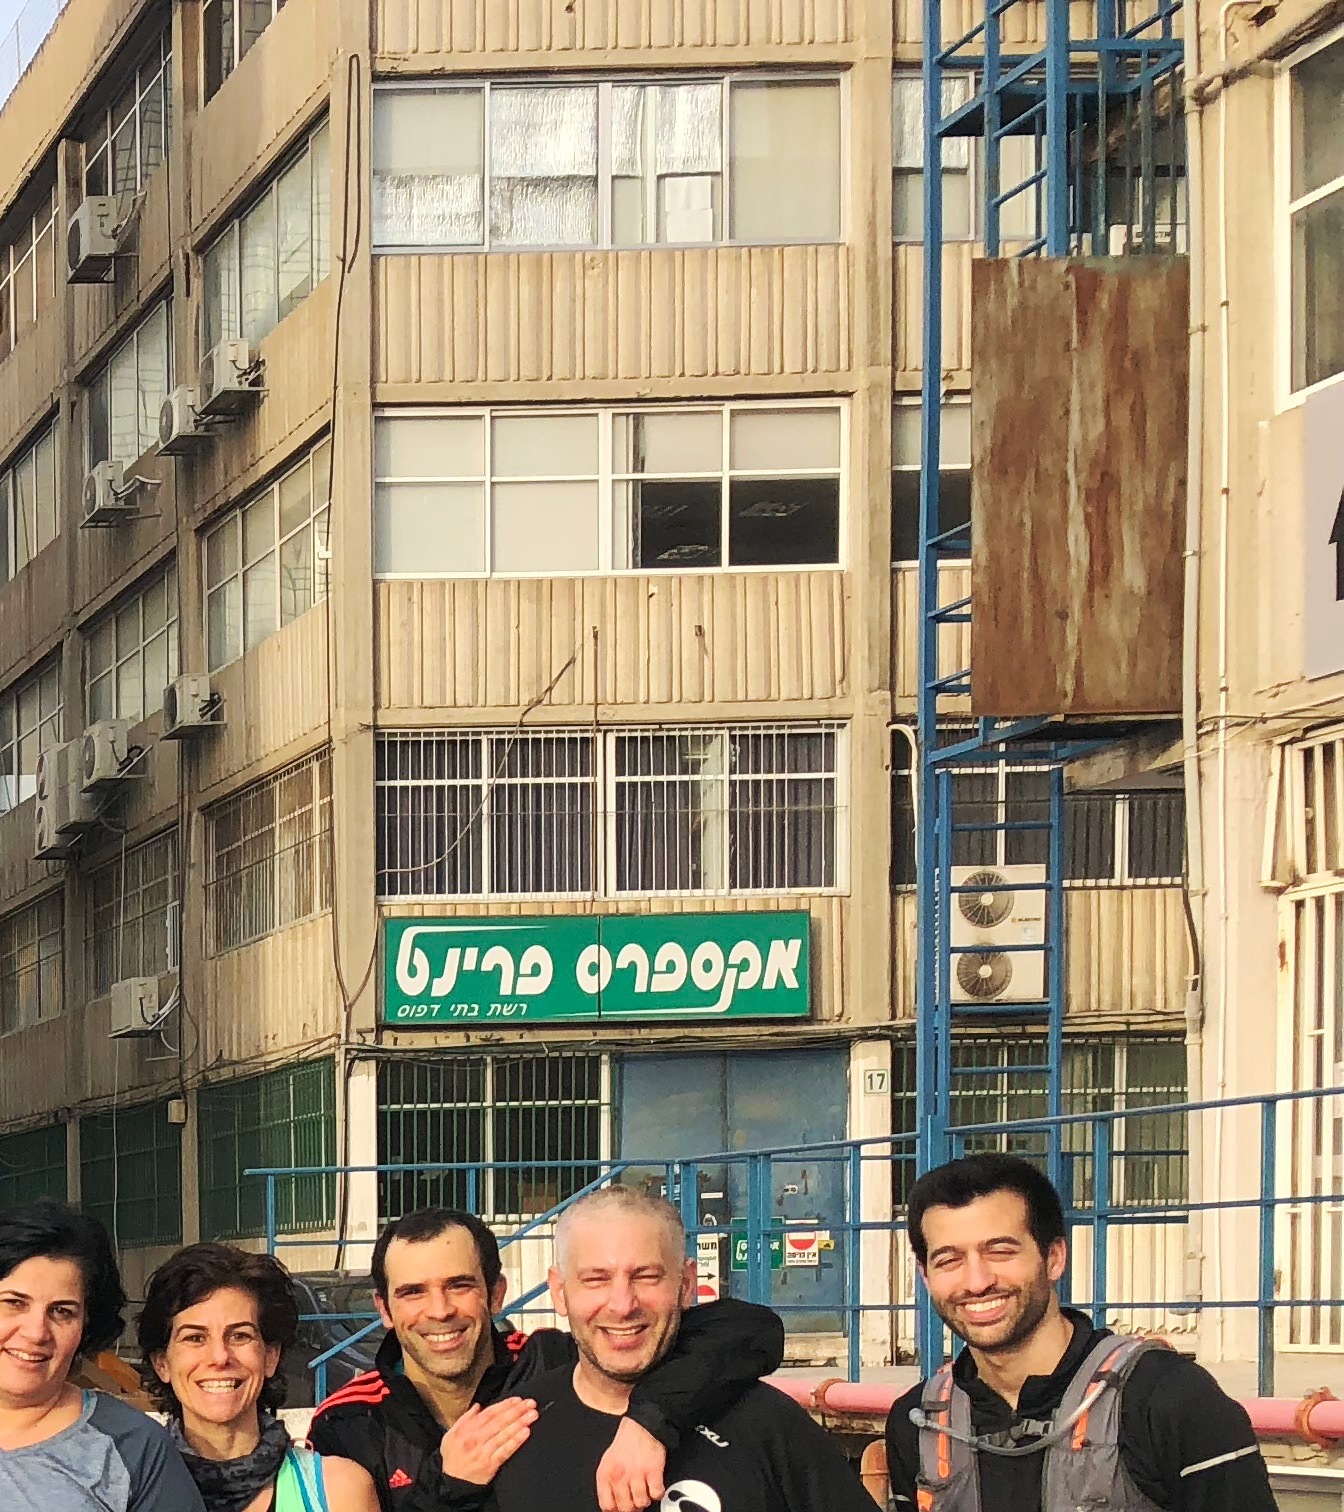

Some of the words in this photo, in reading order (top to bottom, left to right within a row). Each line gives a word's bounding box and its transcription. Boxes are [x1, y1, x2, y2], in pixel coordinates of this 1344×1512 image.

[395, 926, 554, 996] פרינט
[575, 939, 802, 1010] אקספרס
[397, 1004, 441, 1018] דפוס
[449, 1003, 479, 1017] בתי
[486, 1003, 528, 1017] רשת
[867, 1073, 886, 1090] 17
